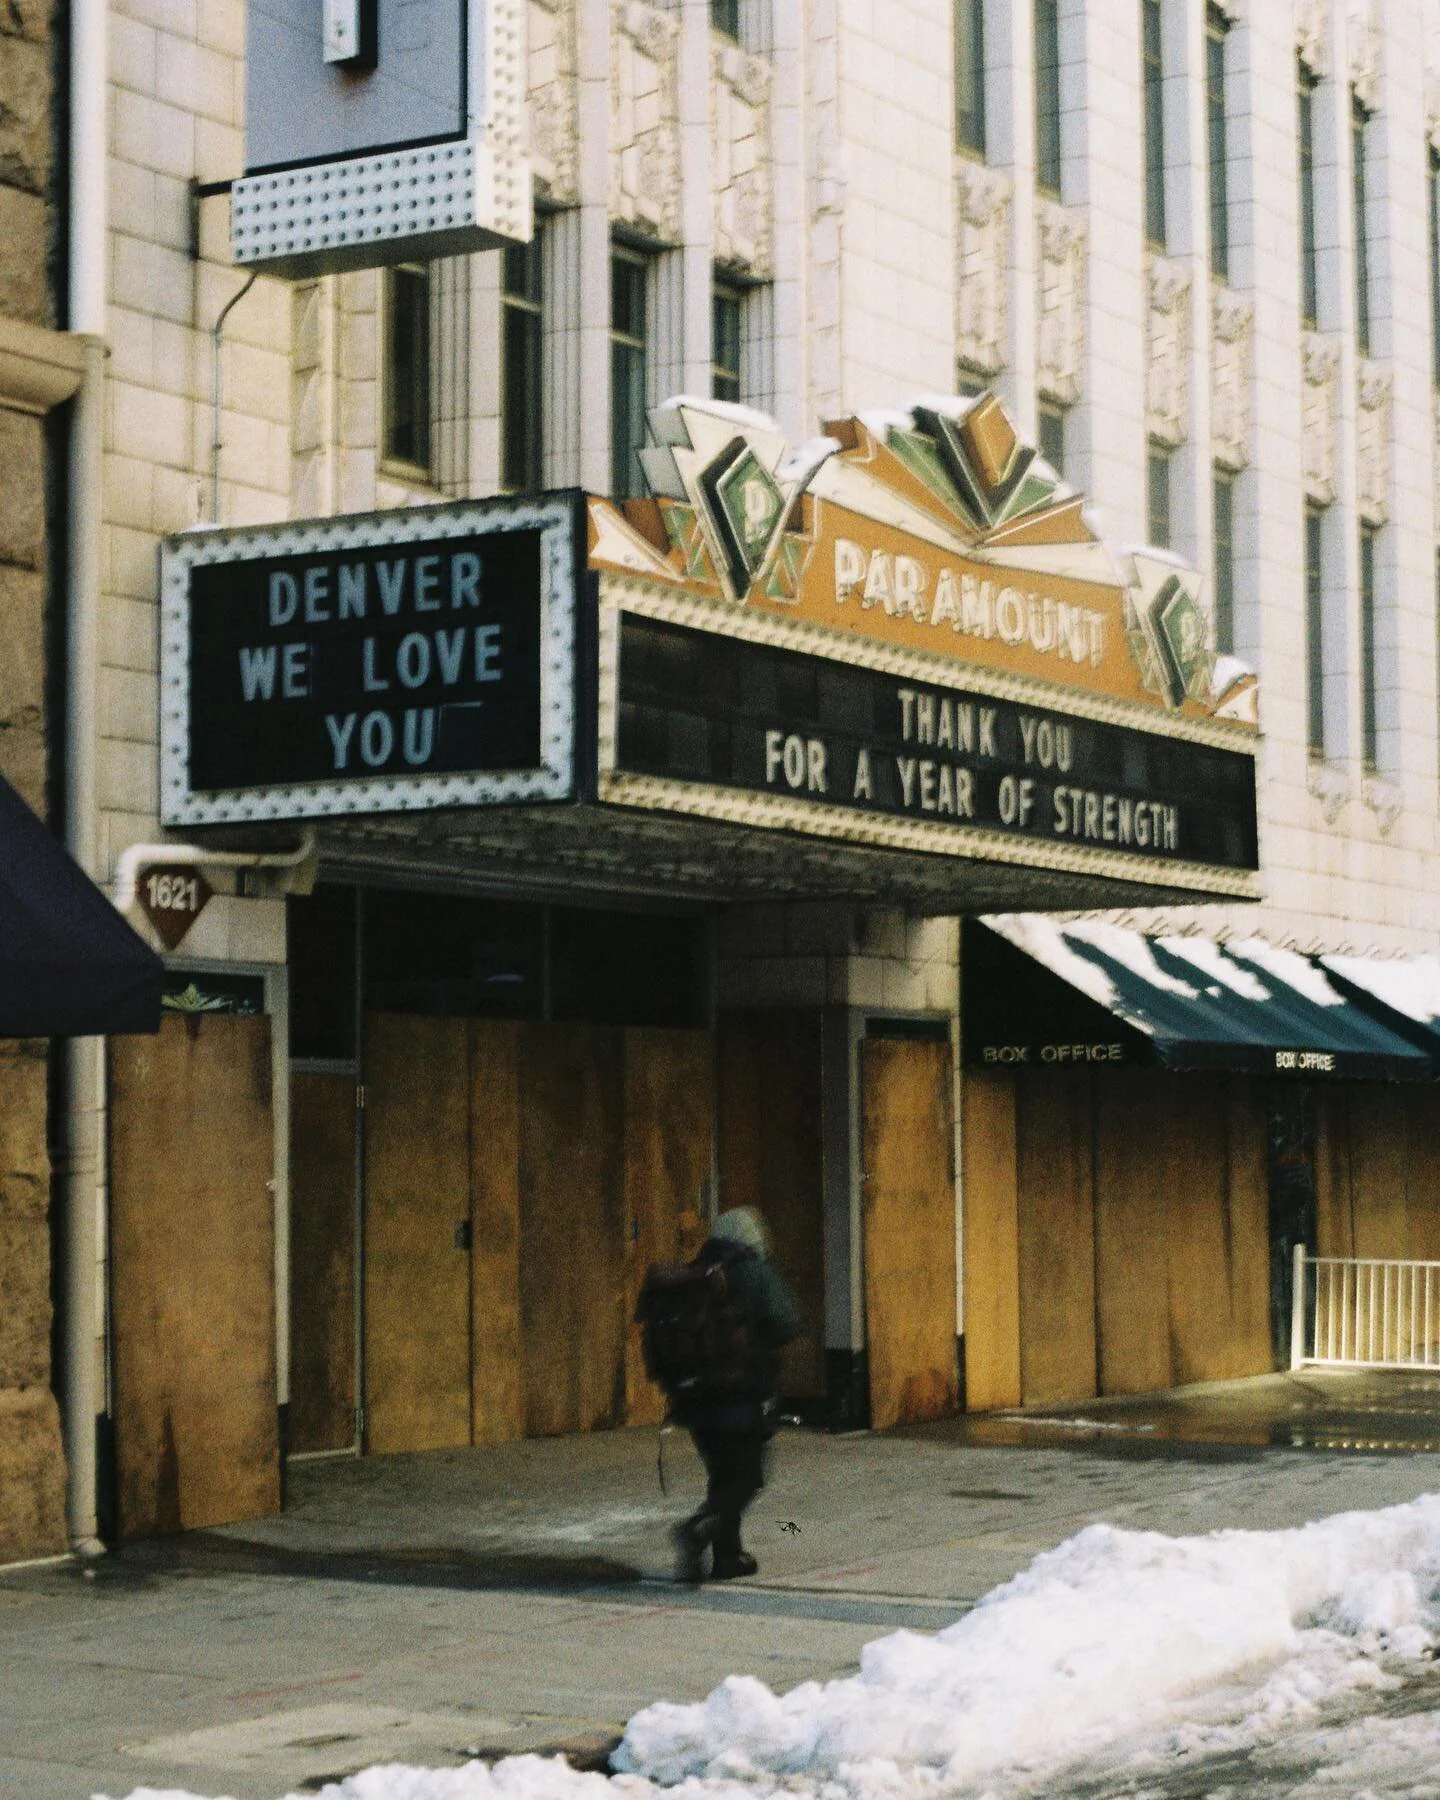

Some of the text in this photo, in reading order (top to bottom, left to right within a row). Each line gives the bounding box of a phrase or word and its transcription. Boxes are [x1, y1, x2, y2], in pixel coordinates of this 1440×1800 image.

[269, 552, 482, 627] DENVER
[834, 537, 1106, 668] PARAMOUNT
[238, 624, 504, 701] WE LOVE
[325, 708, 435, 770] YOU
[899, 689, 1073, 773] THANK YOU
[765, 730, 1180, 850] FOR A YEAR OF STRENGTH
[147, 874, 199, 912] 1621
[983, 1043, 1123, 1063] BOX OFFICE
[1275, 1051, 1336, 1071] BOX OFFICE
